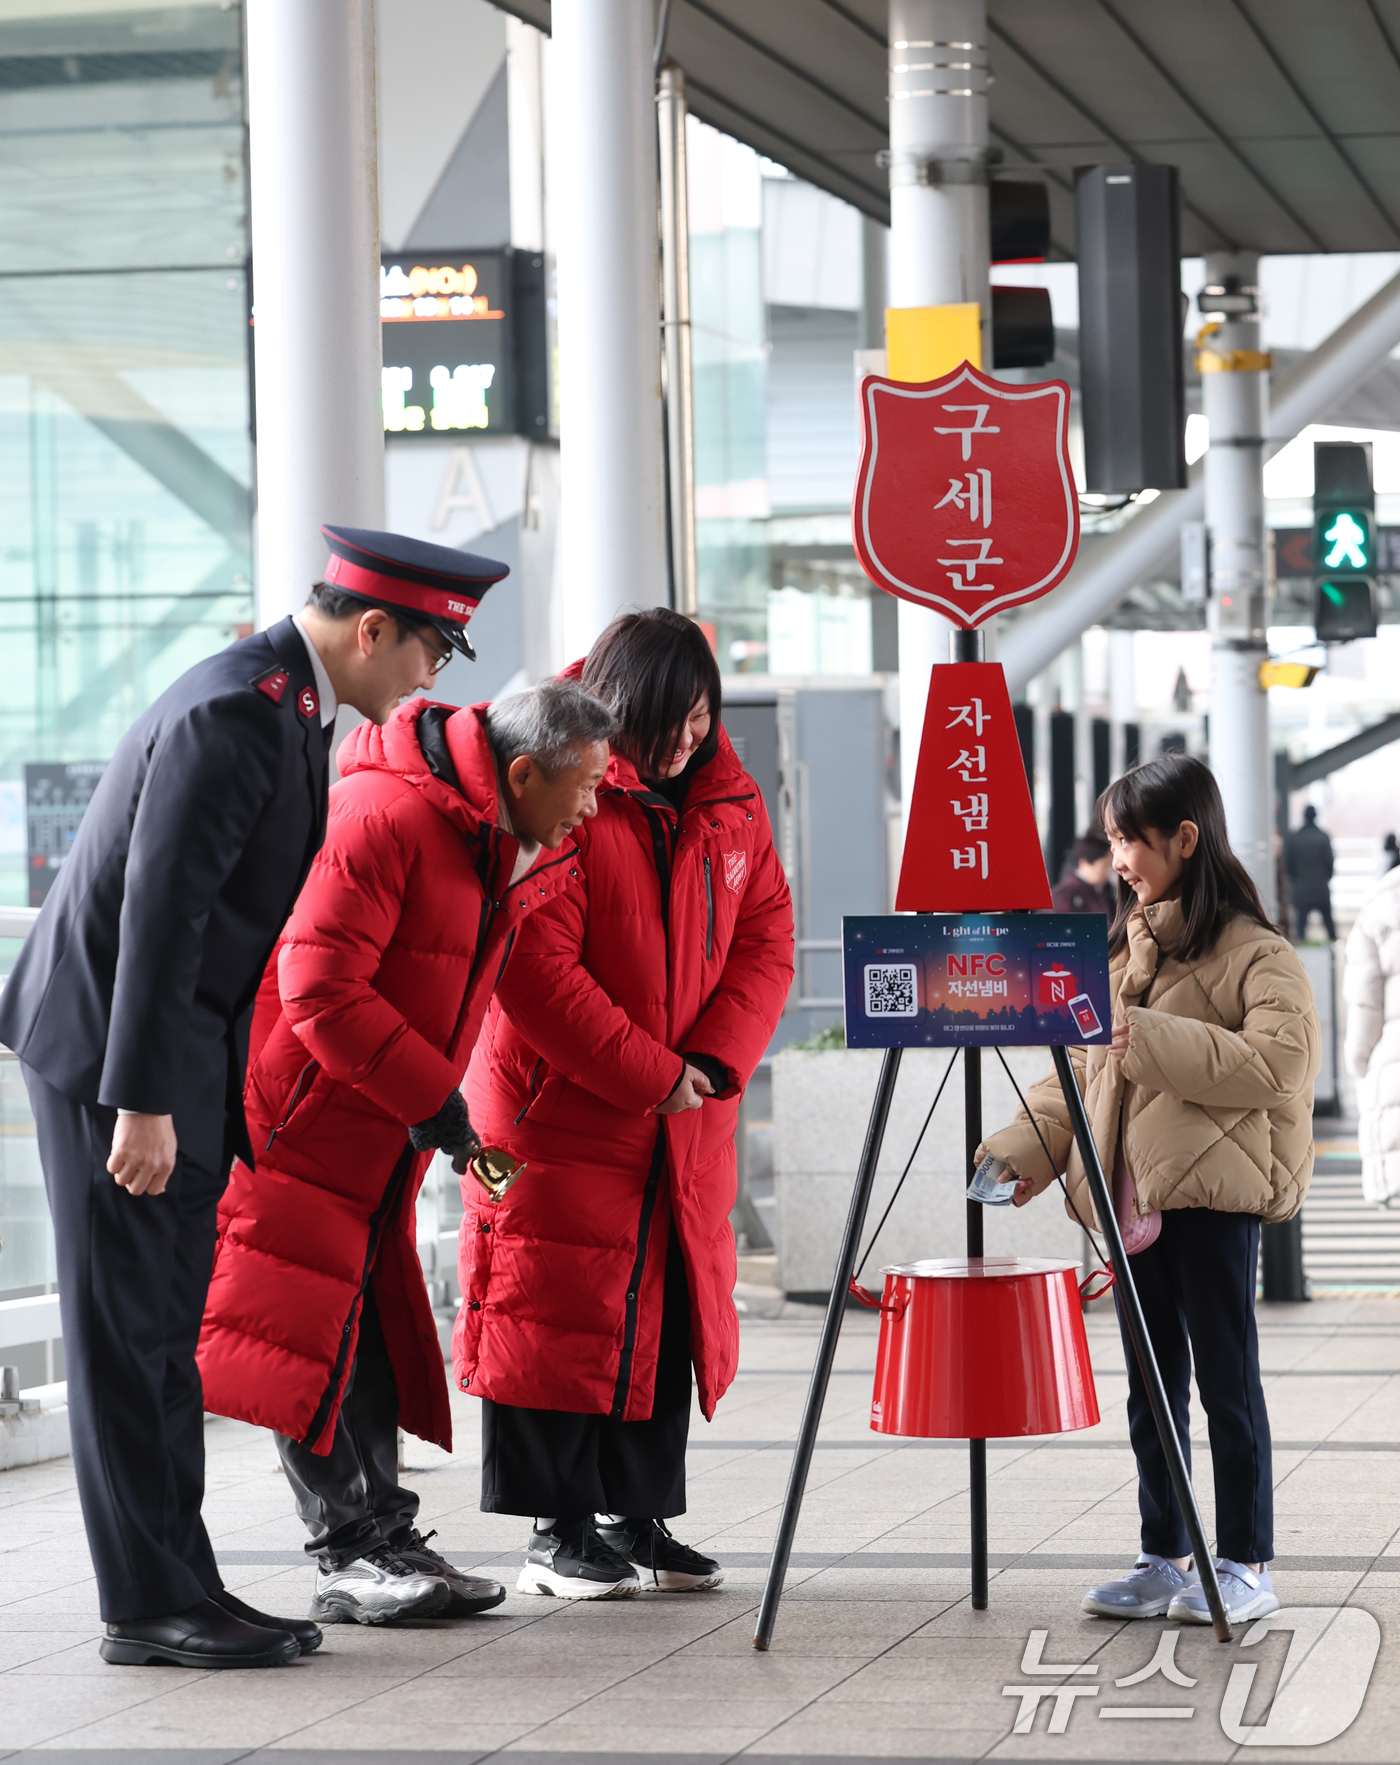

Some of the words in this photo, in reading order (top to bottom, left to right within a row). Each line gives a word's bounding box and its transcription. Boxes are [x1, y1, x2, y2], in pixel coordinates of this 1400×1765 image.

[428, 446, 497, 532] A
[933, 404, 1004, 591] 구세군
[447, 600, 466, 614] THE
[302, 692, 314, 712] S
[945, 698, 992, 880] 자선냄비
[947, 953, 1007, 977] NFC
[948, 980, 1008, 998] 자선냄비
